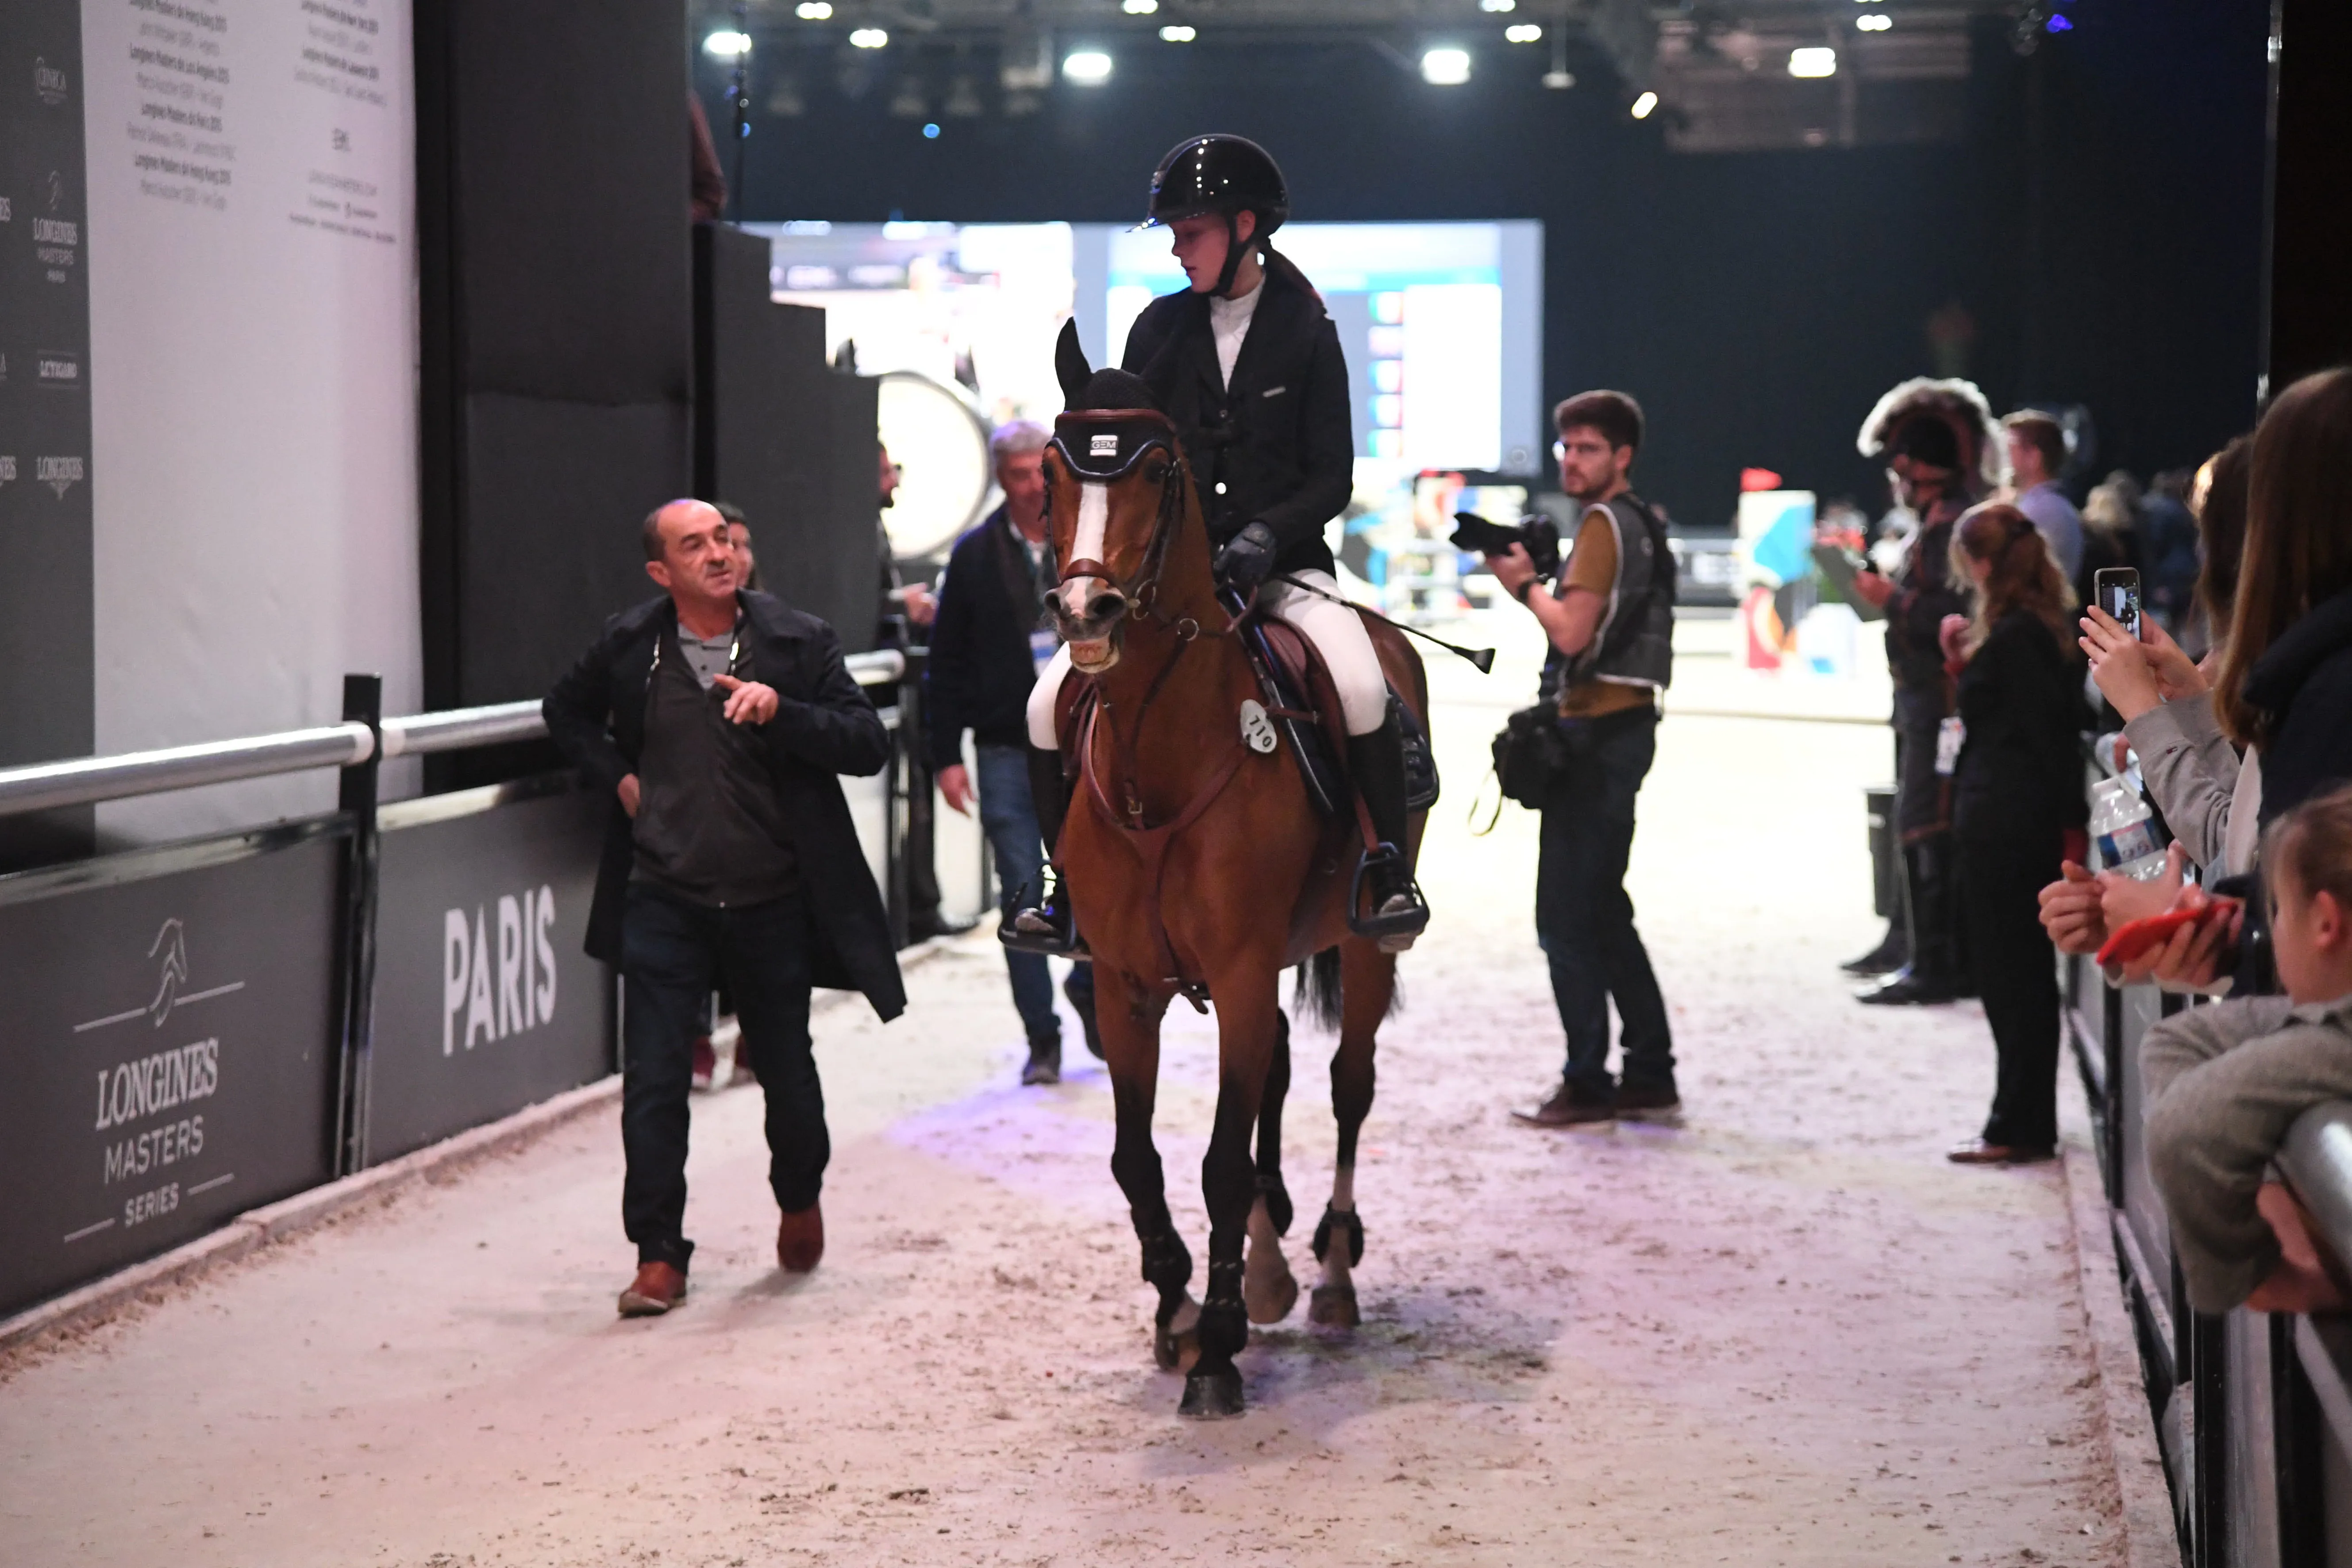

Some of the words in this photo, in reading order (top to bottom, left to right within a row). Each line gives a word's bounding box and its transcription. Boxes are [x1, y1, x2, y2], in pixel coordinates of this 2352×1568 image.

[1092, 441, 1116, 449] GEM
[443, 884, 557, 1057] PARIS
[96, 1037, 219, 1131] LONGINES
[104, 1115, 204, 1185] MASTERS
[124, 1182, 179, 1228] SERIES
